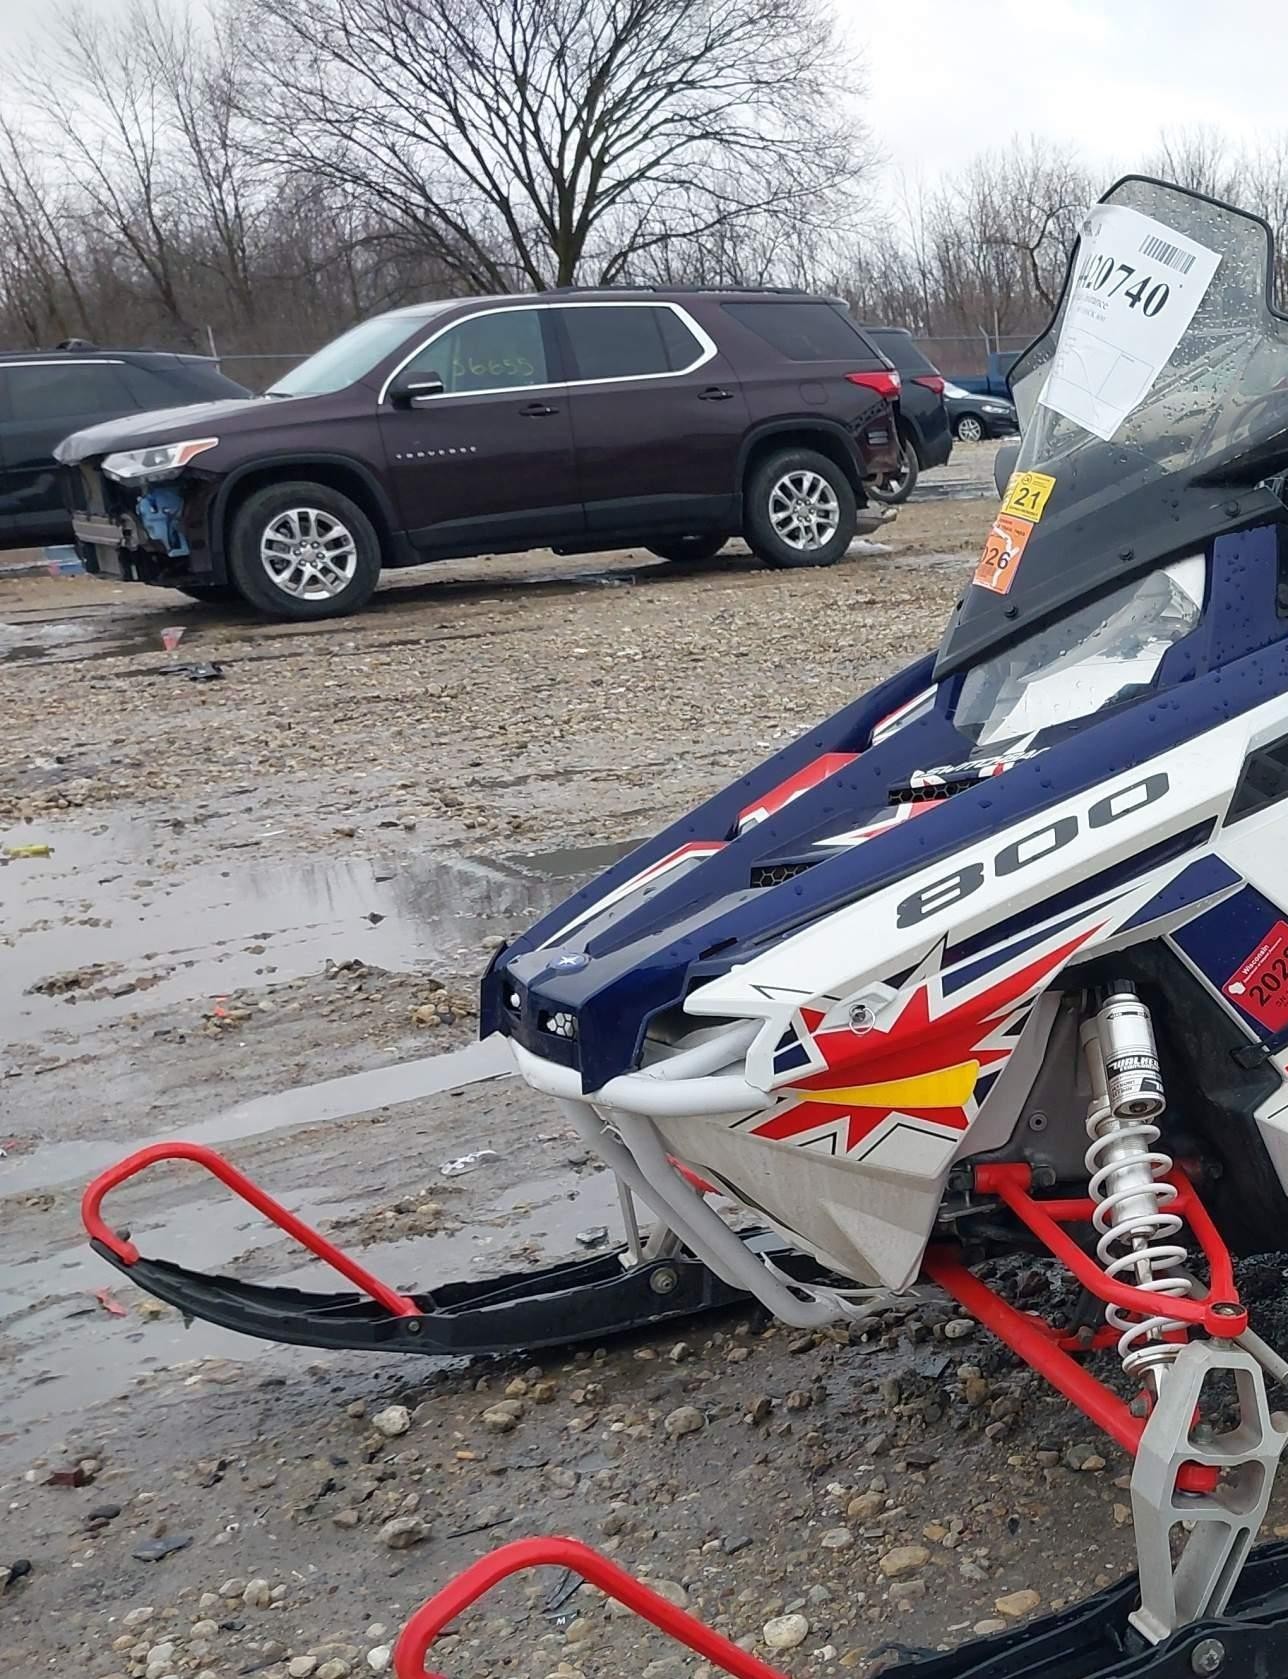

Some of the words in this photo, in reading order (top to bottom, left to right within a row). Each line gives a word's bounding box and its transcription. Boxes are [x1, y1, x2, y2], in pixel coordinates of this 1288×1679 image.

[1014, 487, 1041, 510] 21
[896, 772, 1171, 929] 800
[1241, 944, 1270, 975] Wisconsin
